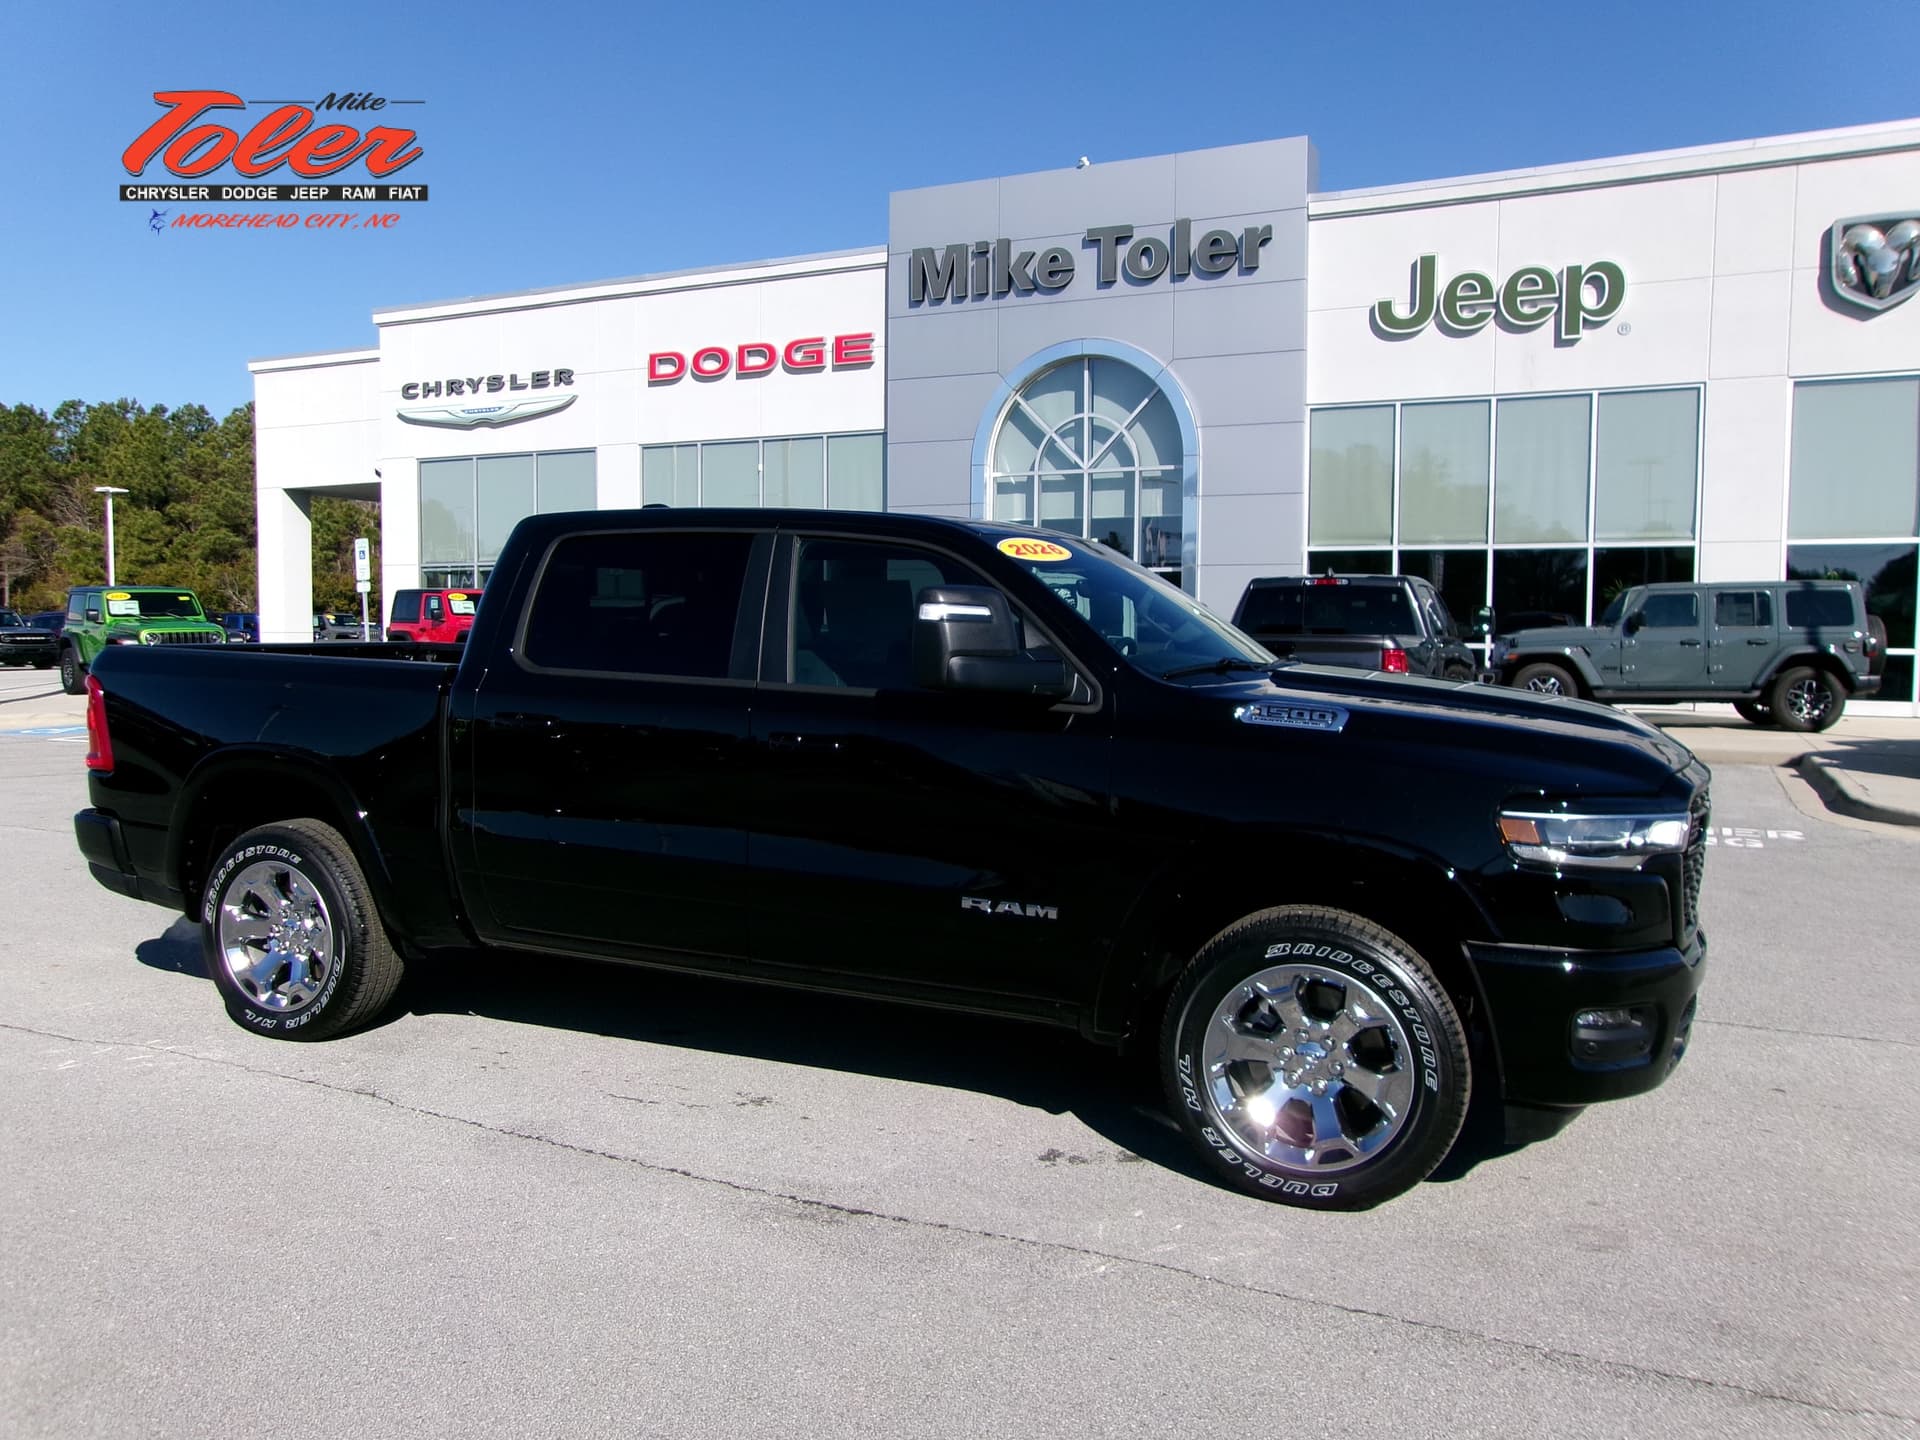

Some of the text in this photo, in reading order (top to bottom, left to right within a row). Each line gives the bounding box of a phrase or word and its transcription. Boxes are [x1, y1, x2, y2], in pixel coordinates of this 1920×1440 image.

[910, 217, 1273, 304] Mike Toler
[1370, 252, 1628, 346] Jeep
[401, 367, 575, 399] CHRYSLER
[648, 332, 876, 386] DODGE
[1008, 543, 1064, 556] 2026
[204, 845, 302, 924] BRIDGESTONE
[961, 896, 1058, 920] RAM
[286, 956, 342, 1029] DUELER
[1265, 943, 1438, 1092] BRIDGESTONE
[1179, 1054, 1338, 1197] DUELER H/L
